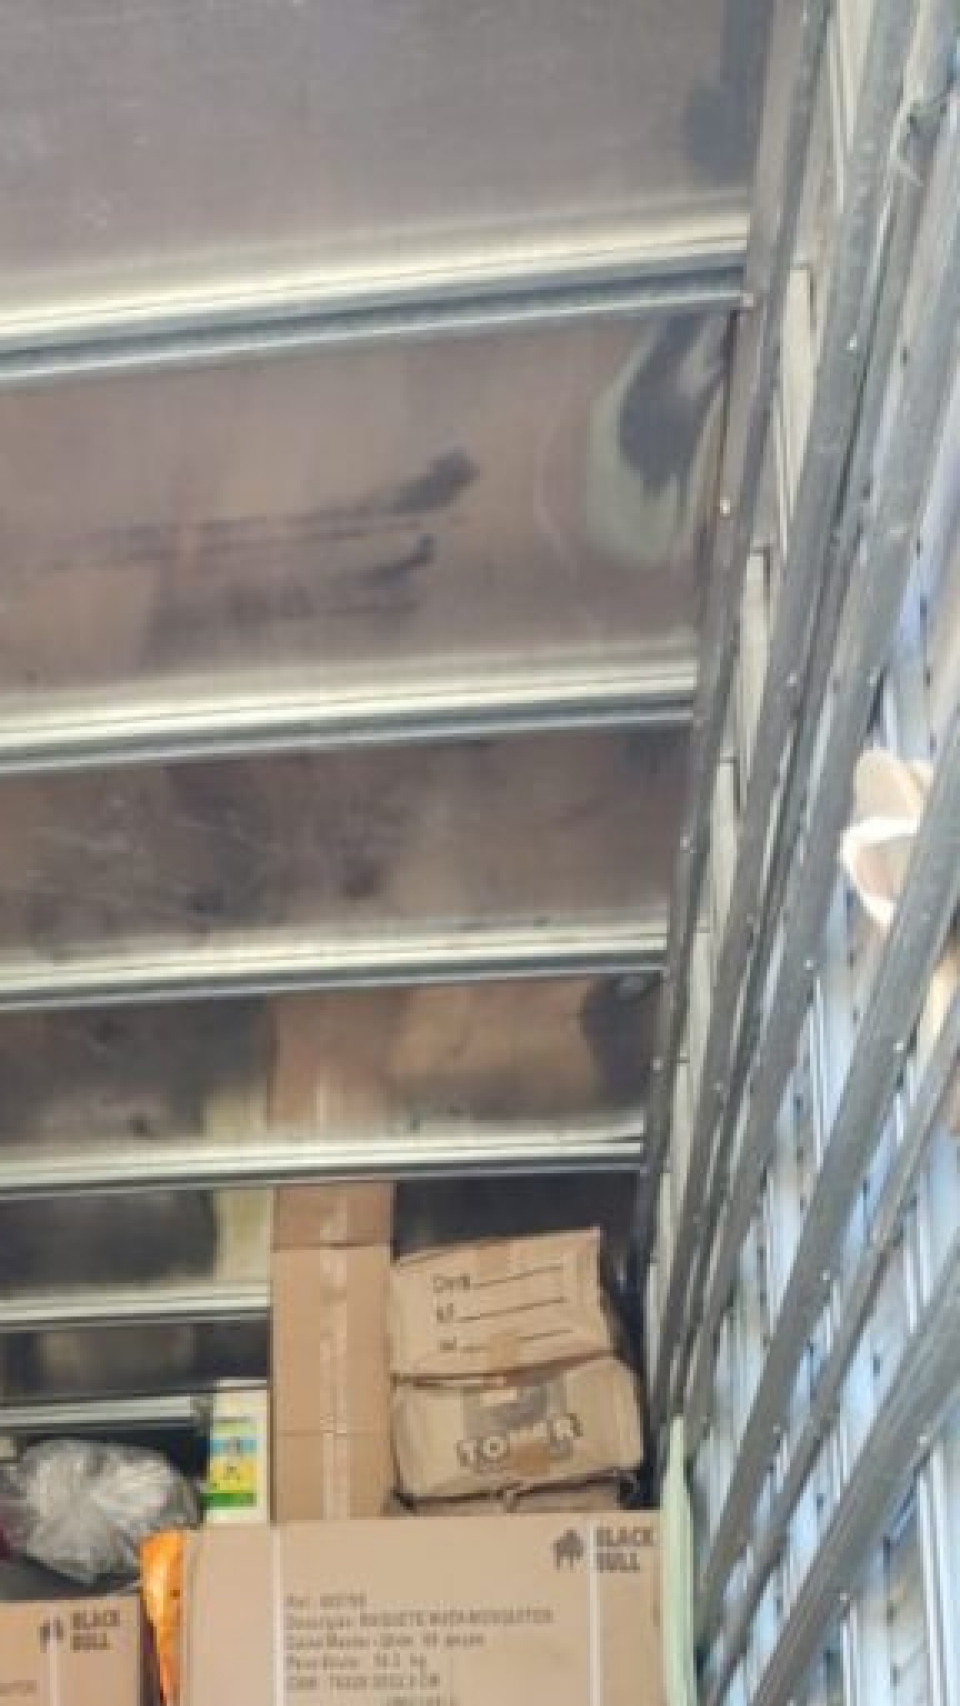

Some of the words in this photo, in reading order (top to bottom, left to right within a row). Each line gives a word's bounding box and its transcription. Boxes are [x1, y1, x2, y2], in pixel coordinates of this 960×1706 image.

[595, 1526, 653, 1546] BLACK
[596, 1552, 640, 1572] BULL
[71, 1610, 120, 1628] BLACK
[71, 1632, 110, 1650] BULL
